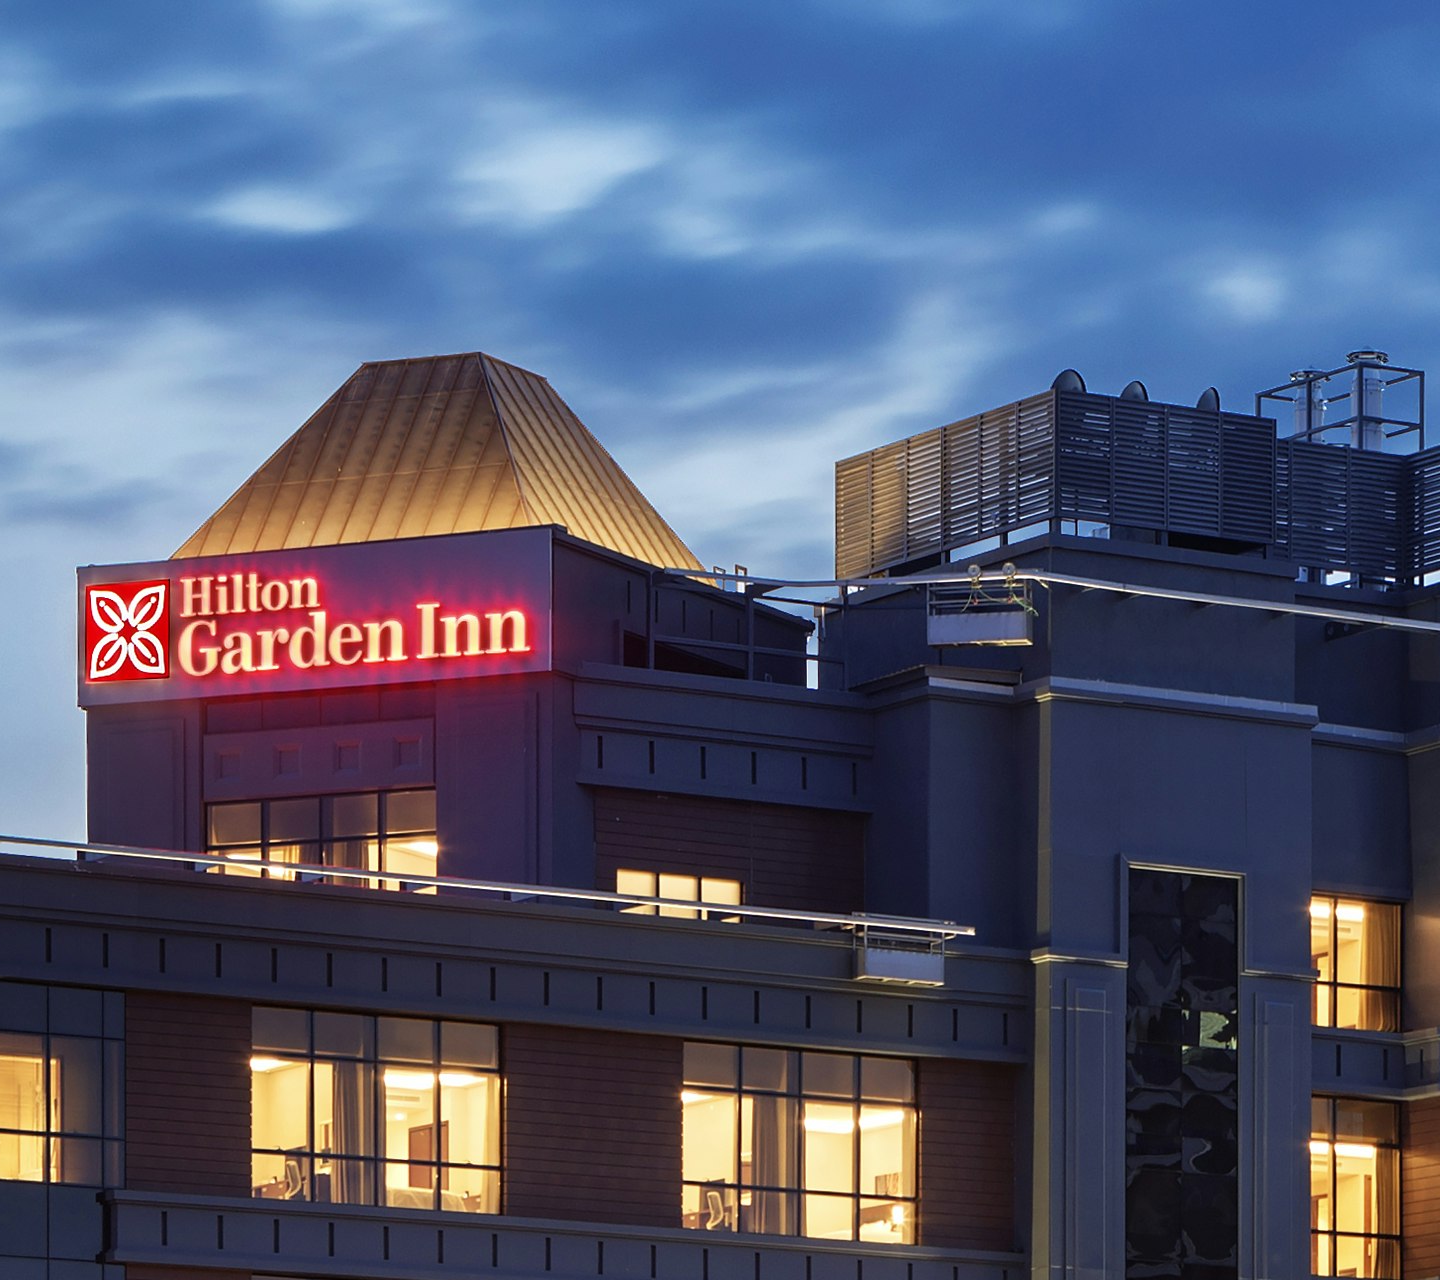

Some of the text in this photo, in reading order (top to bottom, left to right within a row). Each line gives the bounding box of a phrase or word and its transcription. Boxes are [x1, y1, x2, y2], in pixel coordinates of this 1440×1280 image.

[179, 571, 321, 617] Hilton
[177, 601, 531, 677] Garden Inn
